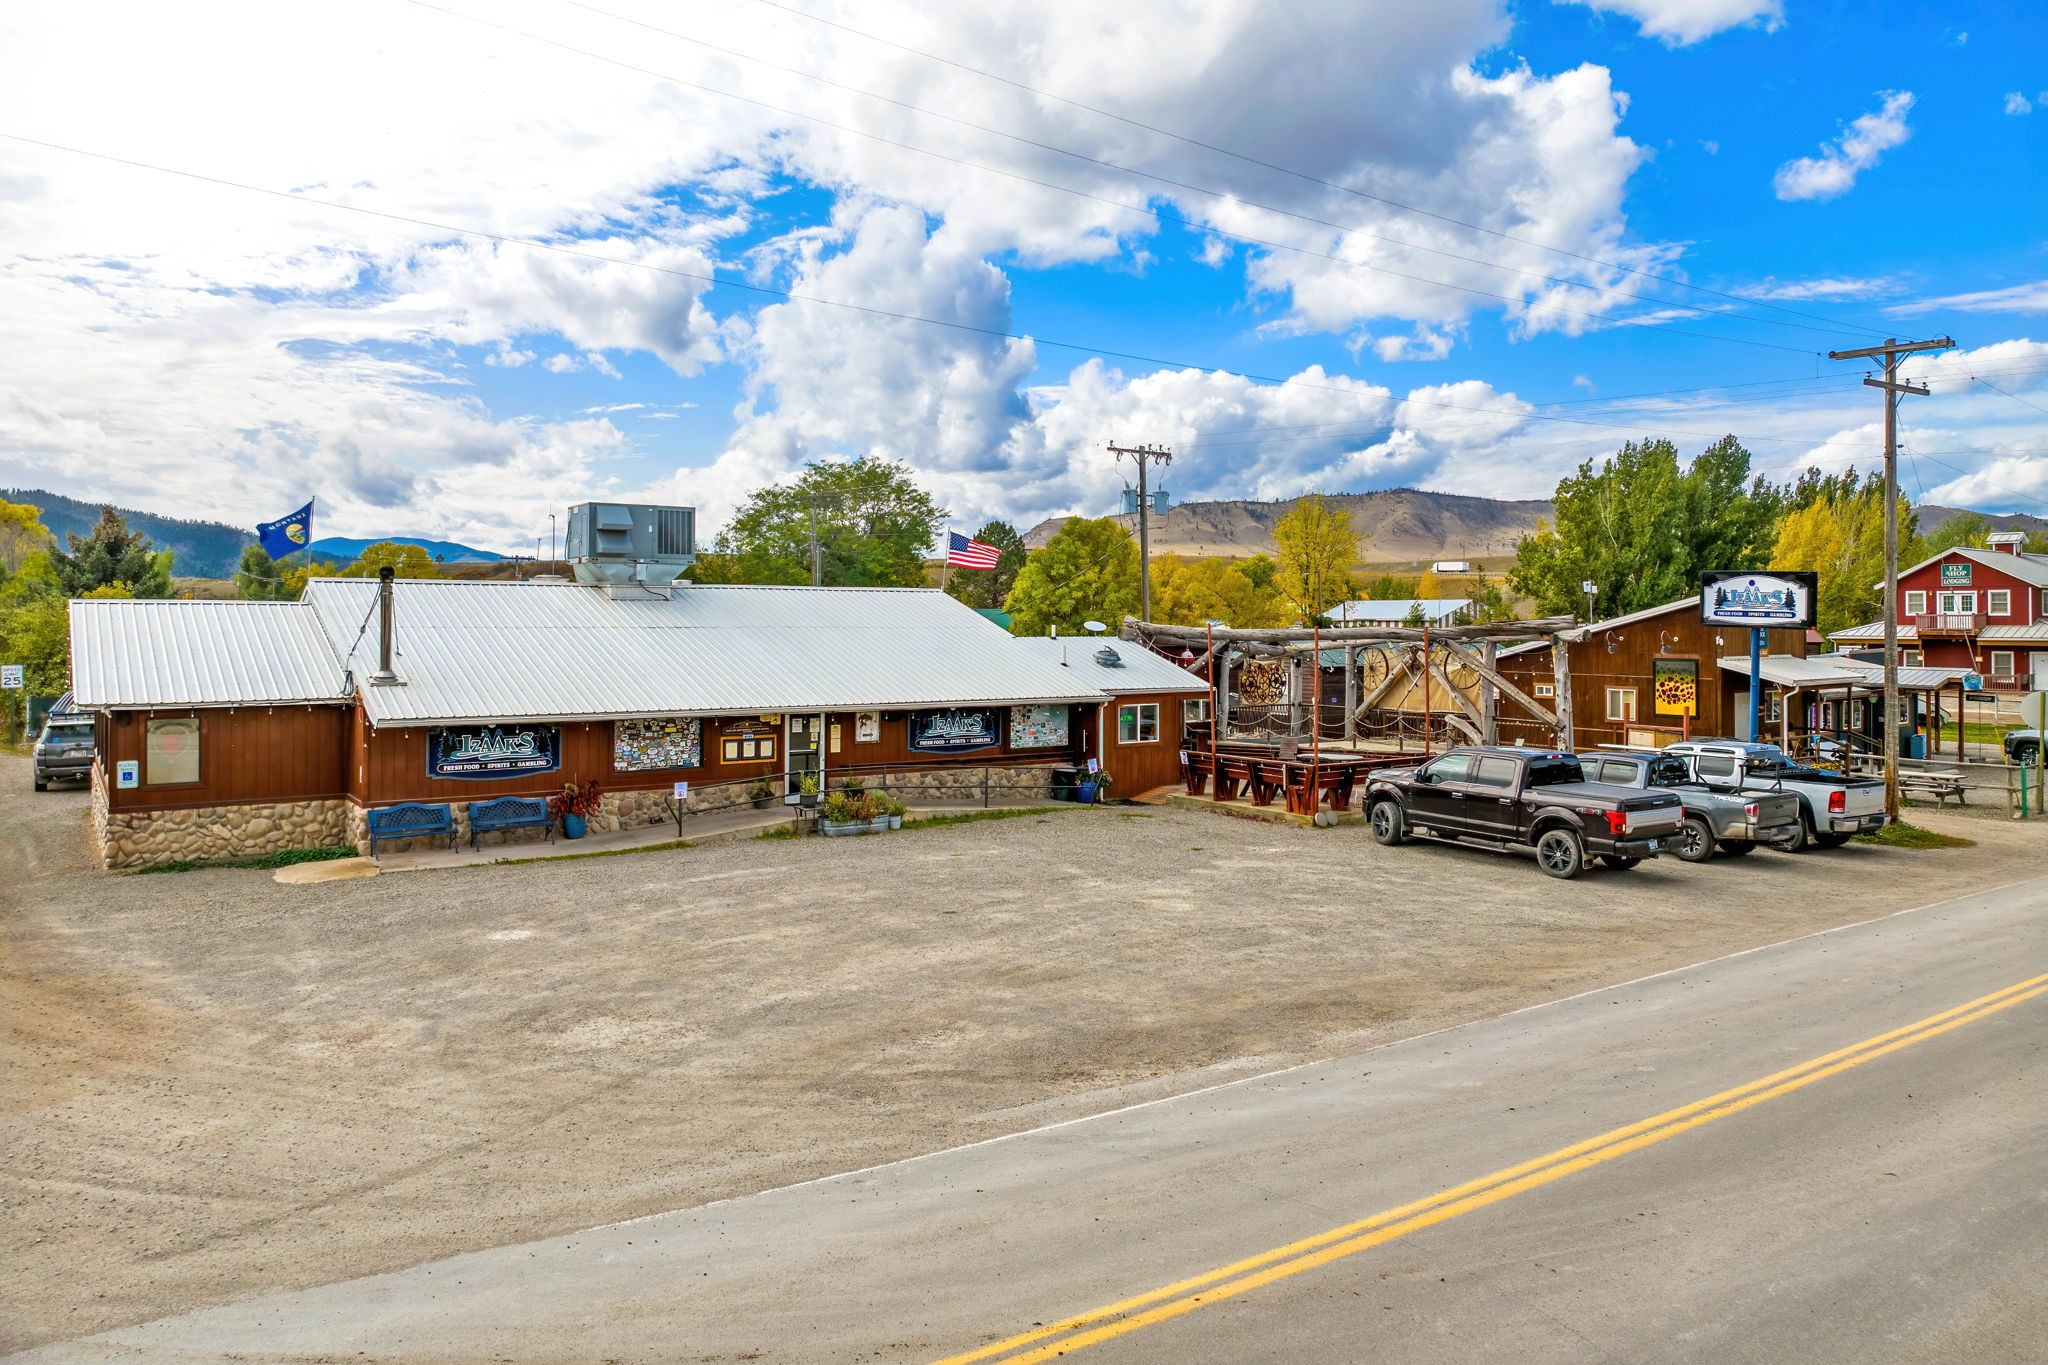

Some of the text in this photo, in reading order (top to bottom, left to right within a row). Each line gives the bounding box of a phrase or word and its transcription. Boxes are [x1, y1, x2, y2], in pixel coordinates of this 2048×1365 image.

[1730, 589, 1783, 605] IZAAK'S
[3, 676, 21, 686] 25
[931, 713, 983, 732] IZAAK'S
[461, 731, 535, 753] IZAAK'S
